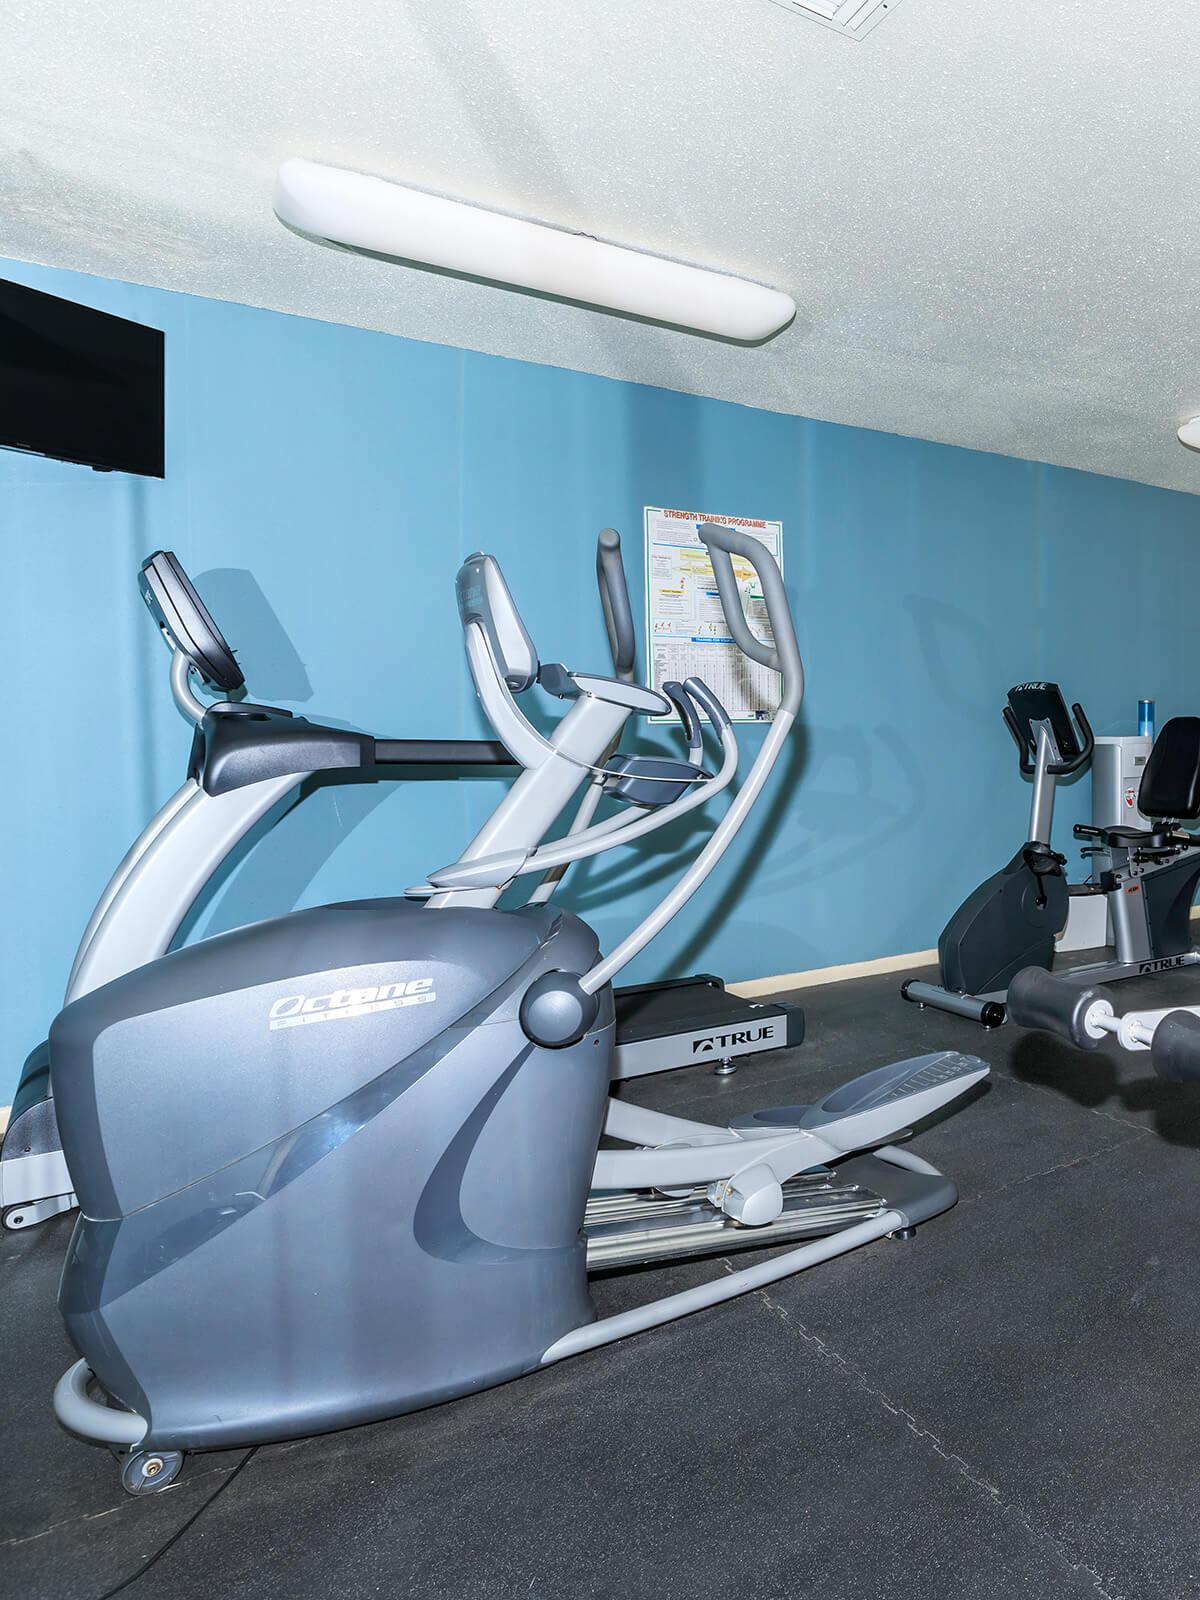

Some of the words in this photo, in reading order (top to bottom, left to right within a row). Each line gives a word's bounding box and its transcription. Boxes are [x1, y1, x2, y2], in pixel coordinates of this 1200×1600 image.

[664, 510, 697, 521] STRENGTH
[728, 517, 767, 529] PROGRAMME
[1152, 955, 1184, 970] TRUE
[269, 978, 434, 1018] Octane
[274, 994, 429, 1028] FITESS
[715, 1025, 774, 1048] TRUE
